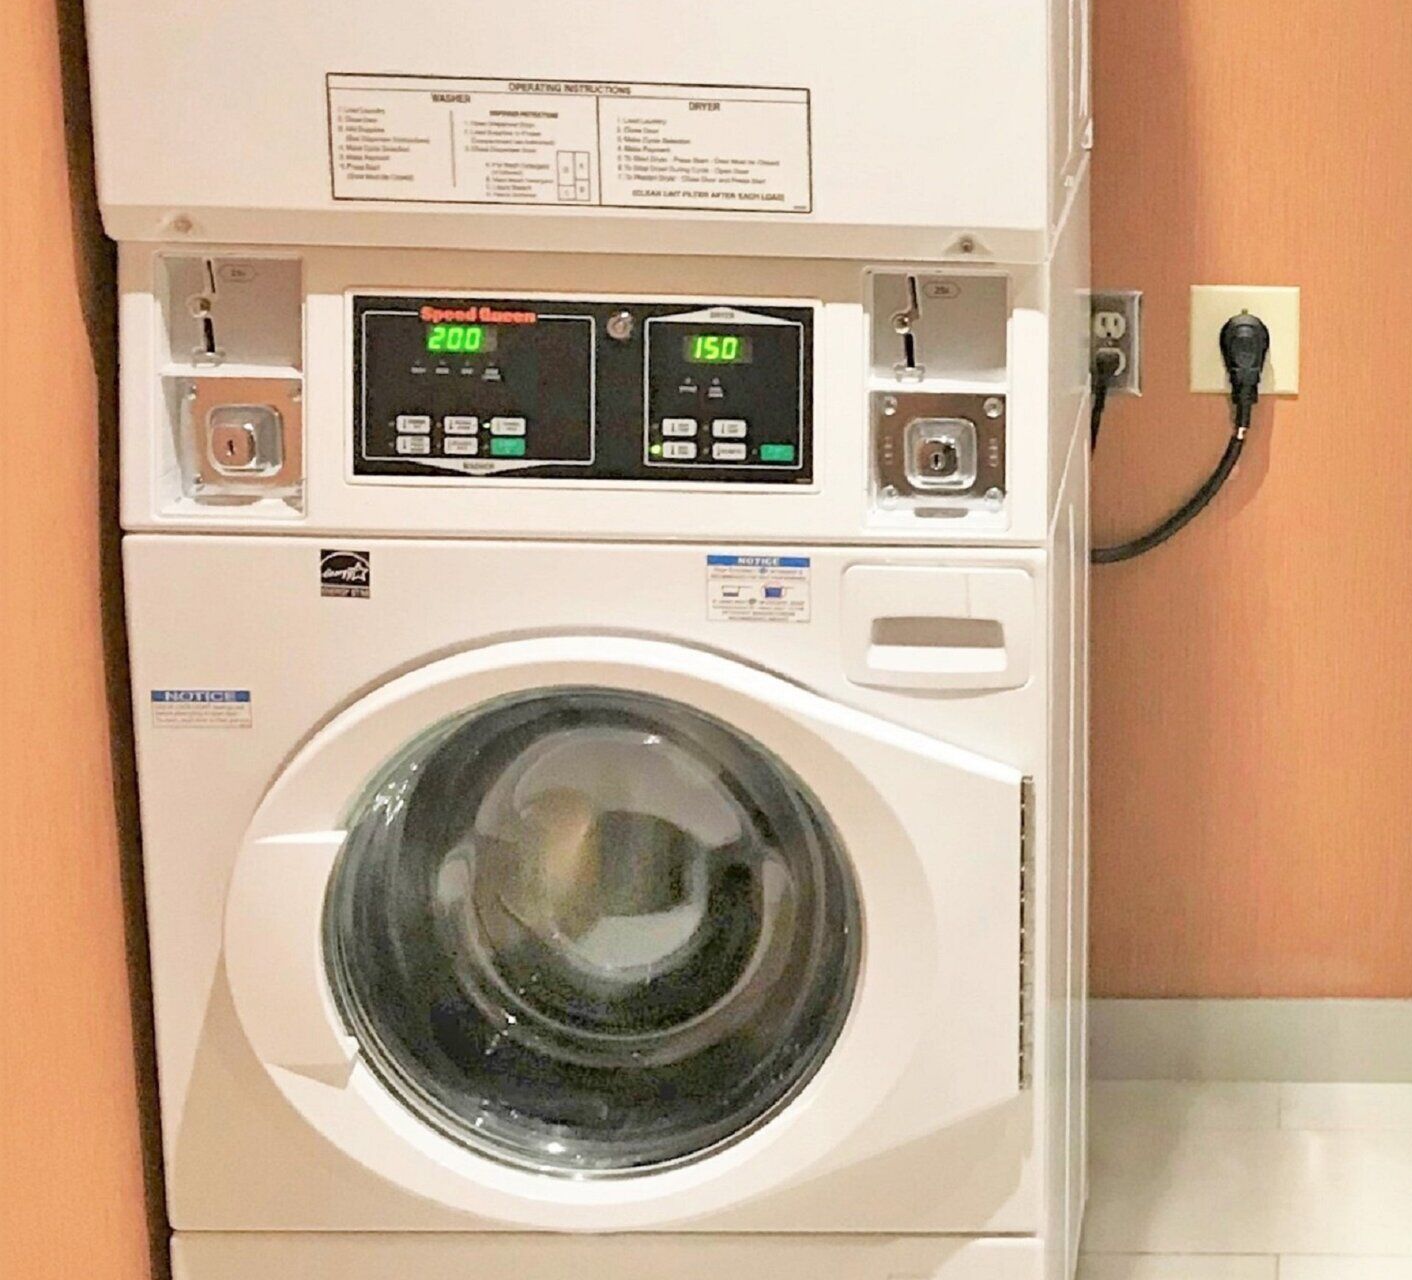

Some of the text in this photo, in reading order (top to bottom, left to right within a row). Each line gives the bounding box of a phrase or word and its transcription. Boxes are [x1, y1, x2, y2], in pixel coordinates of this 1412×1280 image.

[420, 306, 537, 323] Speed Queen
[428, 326, 481, 350] 200
[694, 336, 739, 360] 150
[737, 557, 780, 567] NOTICE
[164, 691, 236, 702] NOTICE
